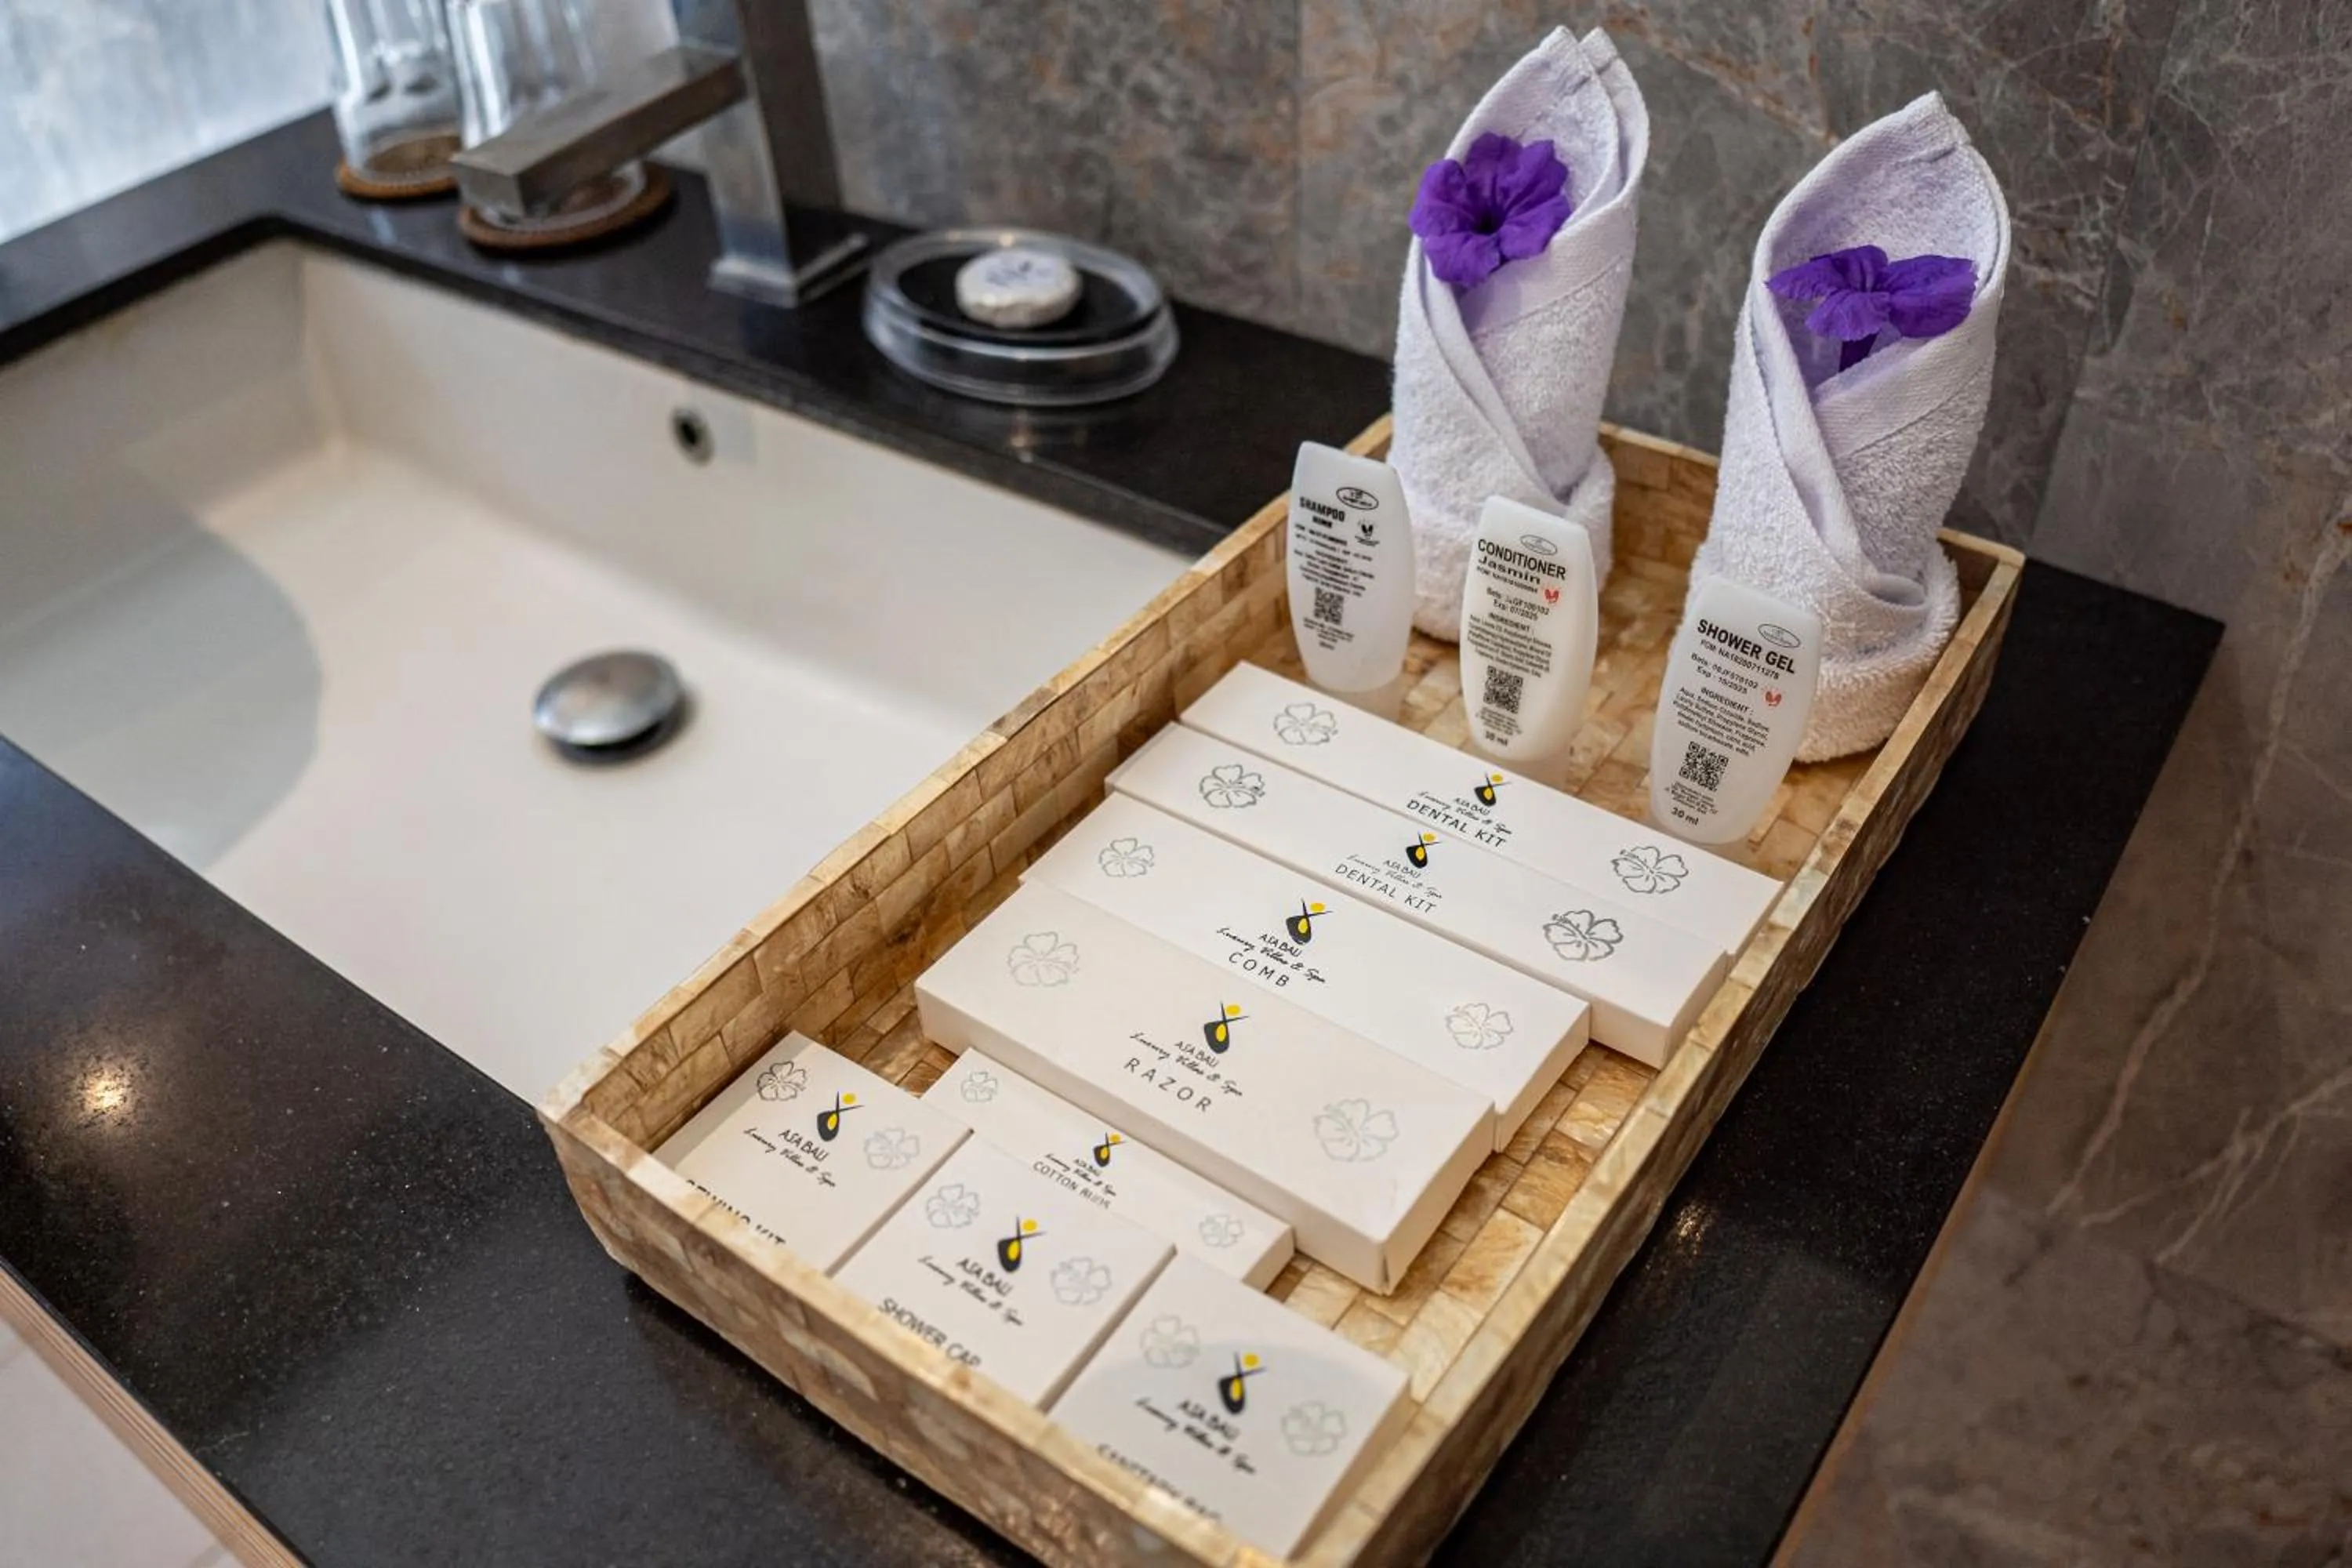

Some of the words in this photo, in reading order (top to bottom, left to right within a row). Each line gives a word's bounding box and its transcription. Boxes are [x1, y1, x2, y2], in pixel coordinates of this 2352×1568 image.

[1300, 496, 1346, 522] SHAMPOO
[1478, 539, 1566, 580] CONDITIONER
[1478, 557, 1541, 585] Jasmin
[1697, 619, 1762, 660] SHOWER
[1766, 651, 1795, 674] GEL
[1406, 800, 1468, 833] DENTAL
[1475, 829, 1507, 848] KIT
[1671, 807, 1685, 820] 30
[1684, 811, 1699, 826] ml
[1335, 863, 1397, 898] DENTAL
[1404, 894, 1436, 913] KIT
[1229, 952, 1290, 987] COMB
[1124, 1058, 1212, 1112] RAZOR
[1033, 1161, 1079, 1191] COTTON
[878, 1297, 948, 1348] SHOWER
